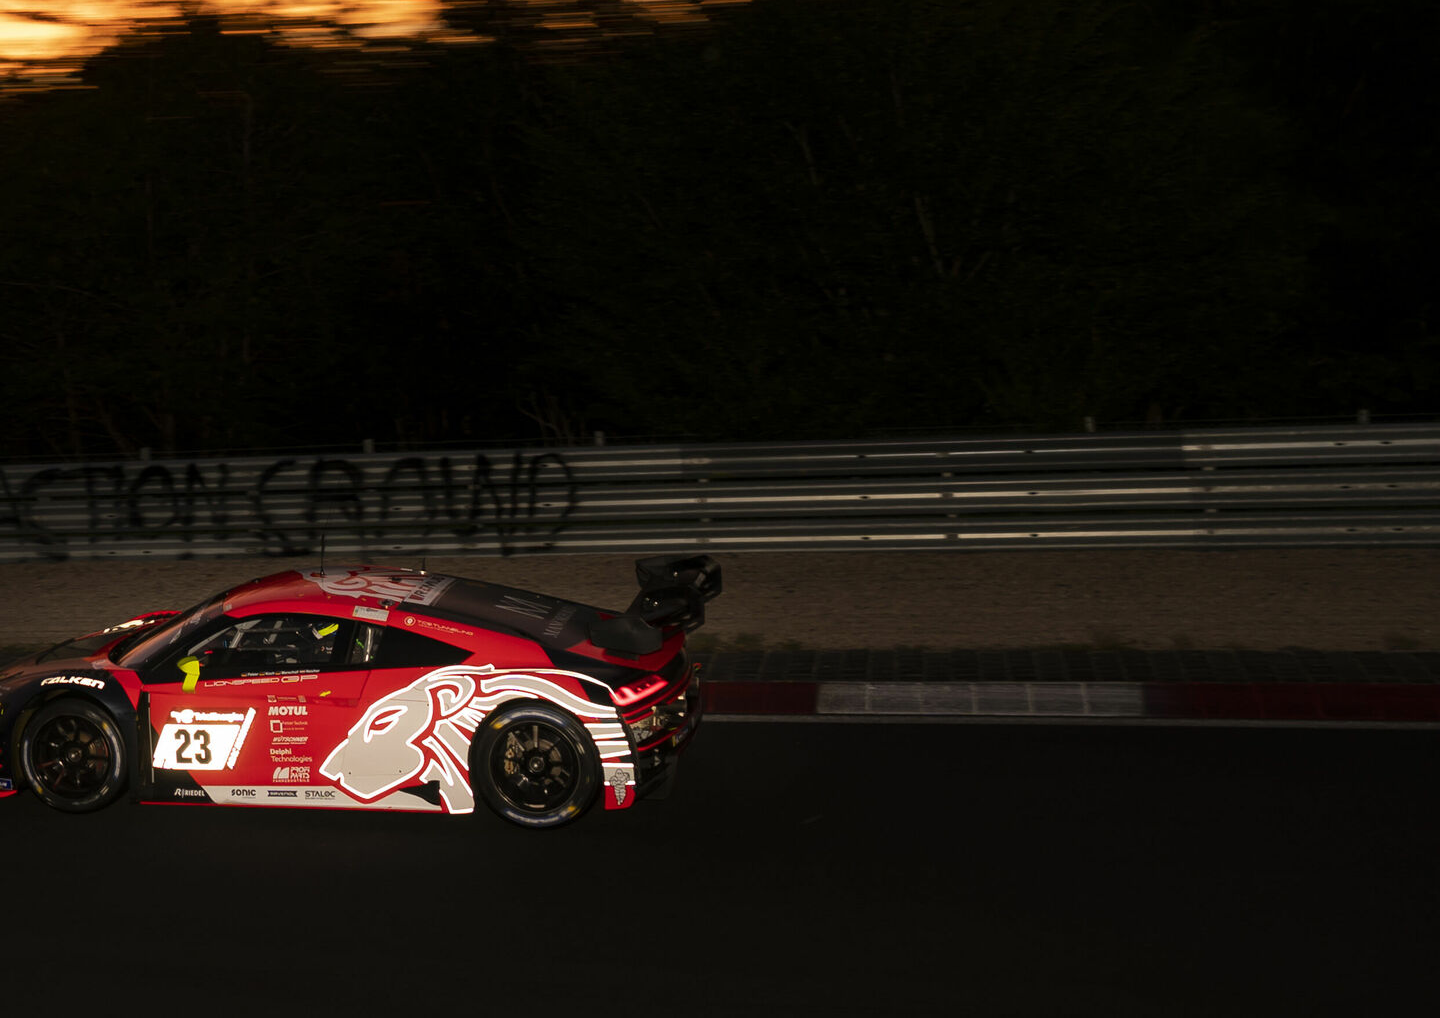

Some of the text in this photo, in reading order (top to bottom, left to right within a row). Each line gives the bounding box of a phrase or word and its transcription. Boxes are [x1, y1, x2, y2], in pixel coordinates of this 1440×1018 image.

[40, 676, 106, 690] FALKEN
[204, 674, 318, 687] LIONSPEED GP
[268, 705, 308, 716] MOTUL
[174, 729, 212, 764] 23
[270, 748, 292, 756] Delphi
[270, 755, 313, 763] Technologies
